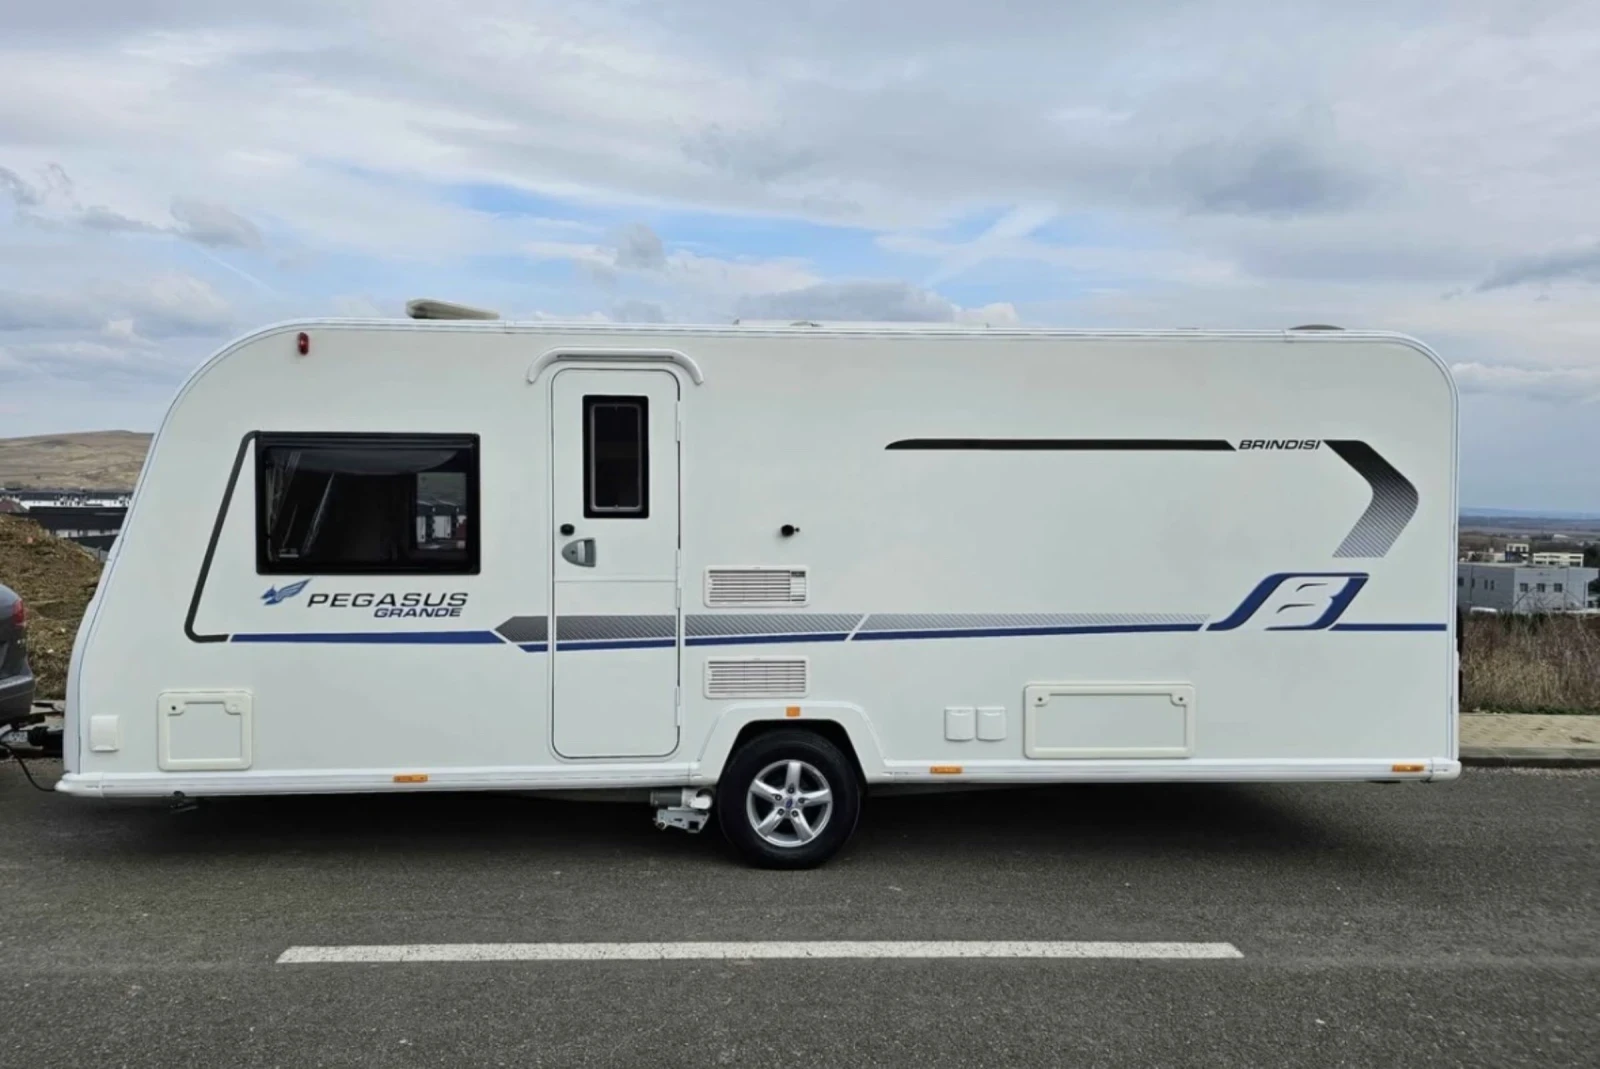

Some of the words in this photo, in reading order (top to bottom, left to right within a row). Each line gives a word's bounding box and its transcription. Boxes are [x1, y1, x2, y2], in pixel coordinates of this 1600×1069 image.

[1238, 439, 1321, 450] BRINDISI
[307, 592, 469, 608] PEGASUS
[373, 607, 463, 618] GRANDE
